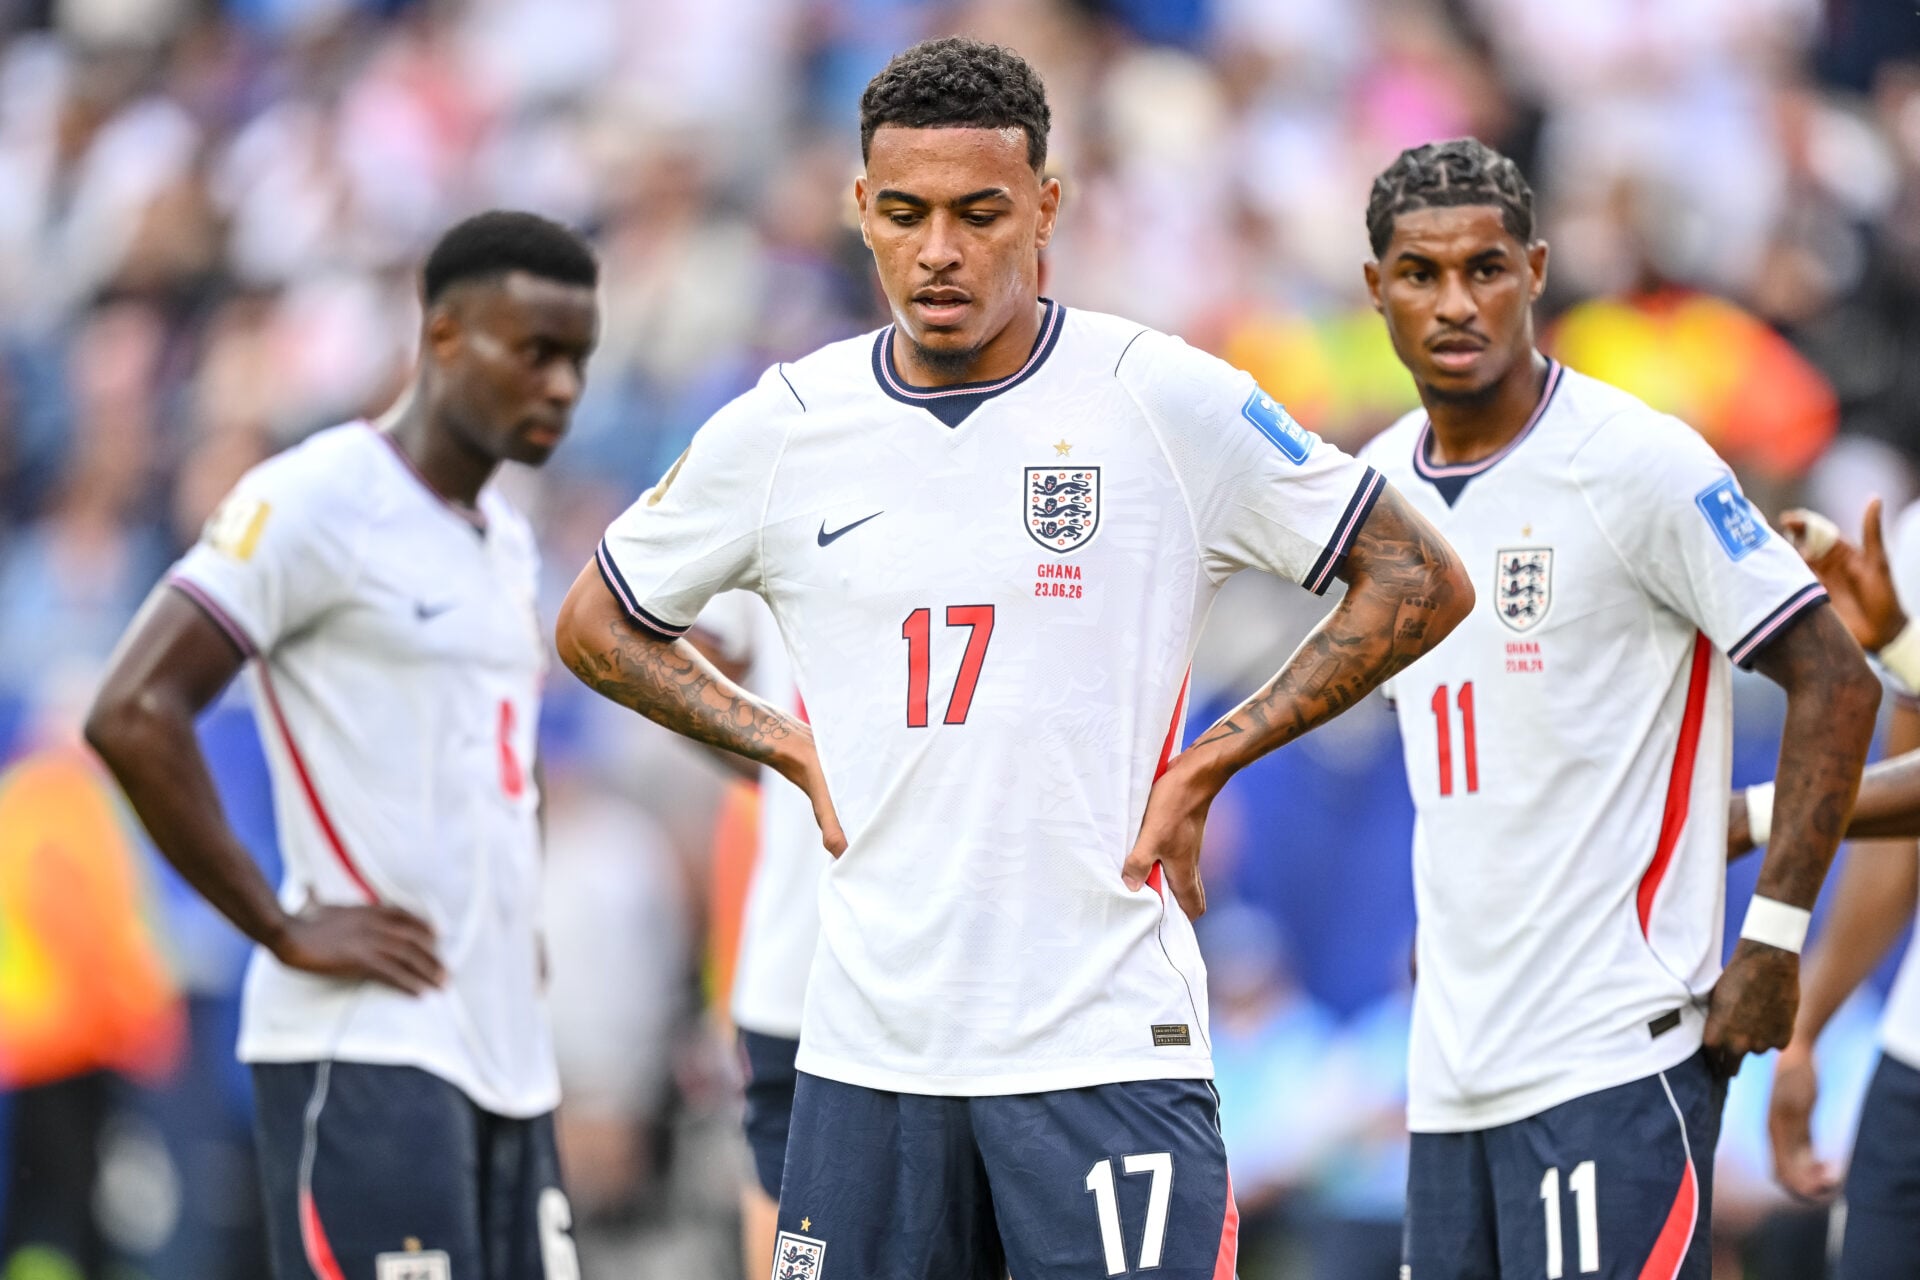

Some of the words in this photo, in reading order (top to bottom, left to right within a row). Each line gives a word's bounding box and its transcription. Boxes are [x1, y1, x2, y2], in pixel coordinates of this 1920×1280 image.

[1035, 582, 1083, 599] 23.06.26
[1037, 564, 1082, 580] GHANA
[902, 604, 995, 728] 17
[1430, 680, 1479, 797] 11
[1084, 1150, 1175, 1277] 17
[1540, 1160, 1599, 1279] 11
